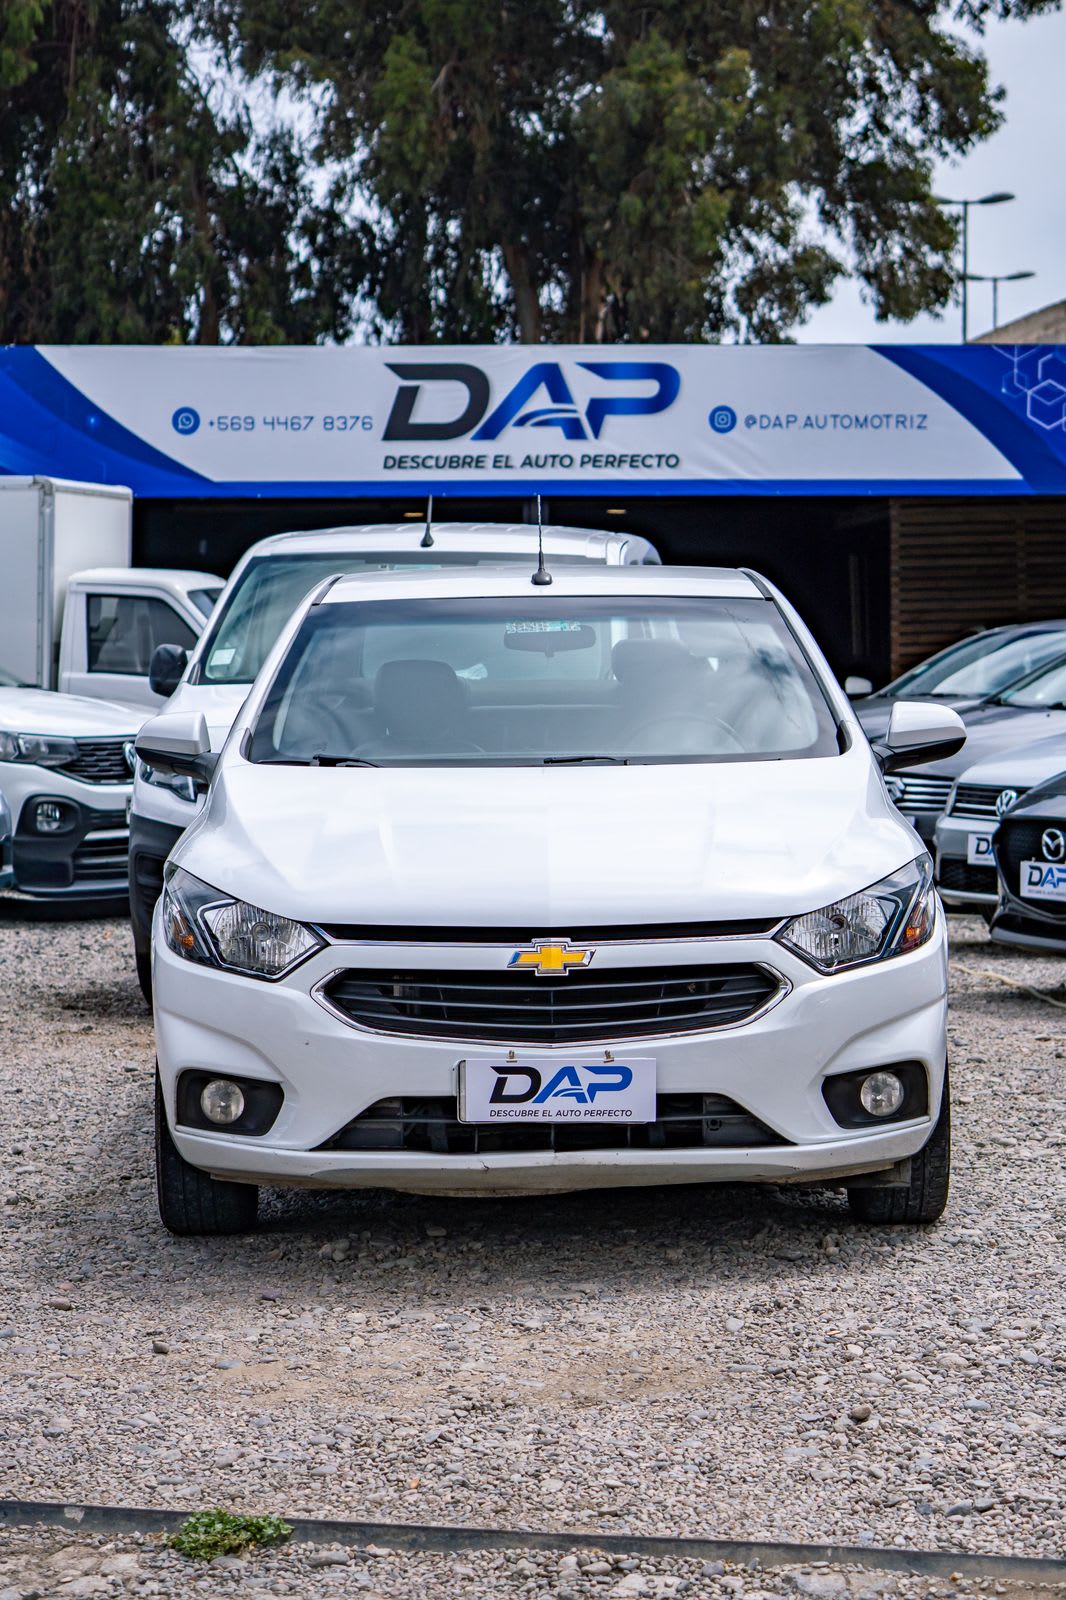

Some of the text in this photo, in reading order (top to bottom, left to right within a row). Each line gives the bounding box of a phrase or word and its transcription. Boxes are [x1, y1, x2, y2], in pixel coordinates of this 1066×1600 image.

[382, 362, 681, 441] DAP
[208, 415, 373, 432] +569 4467 8376
[383, 453, 681, 470] DESCUBRE EL AUTO PERFECTO
[489, 1066, 633, 1103] DAP
[489, 1109, 633, 1117] DESCUBRE EL AUTO PERFECTO
